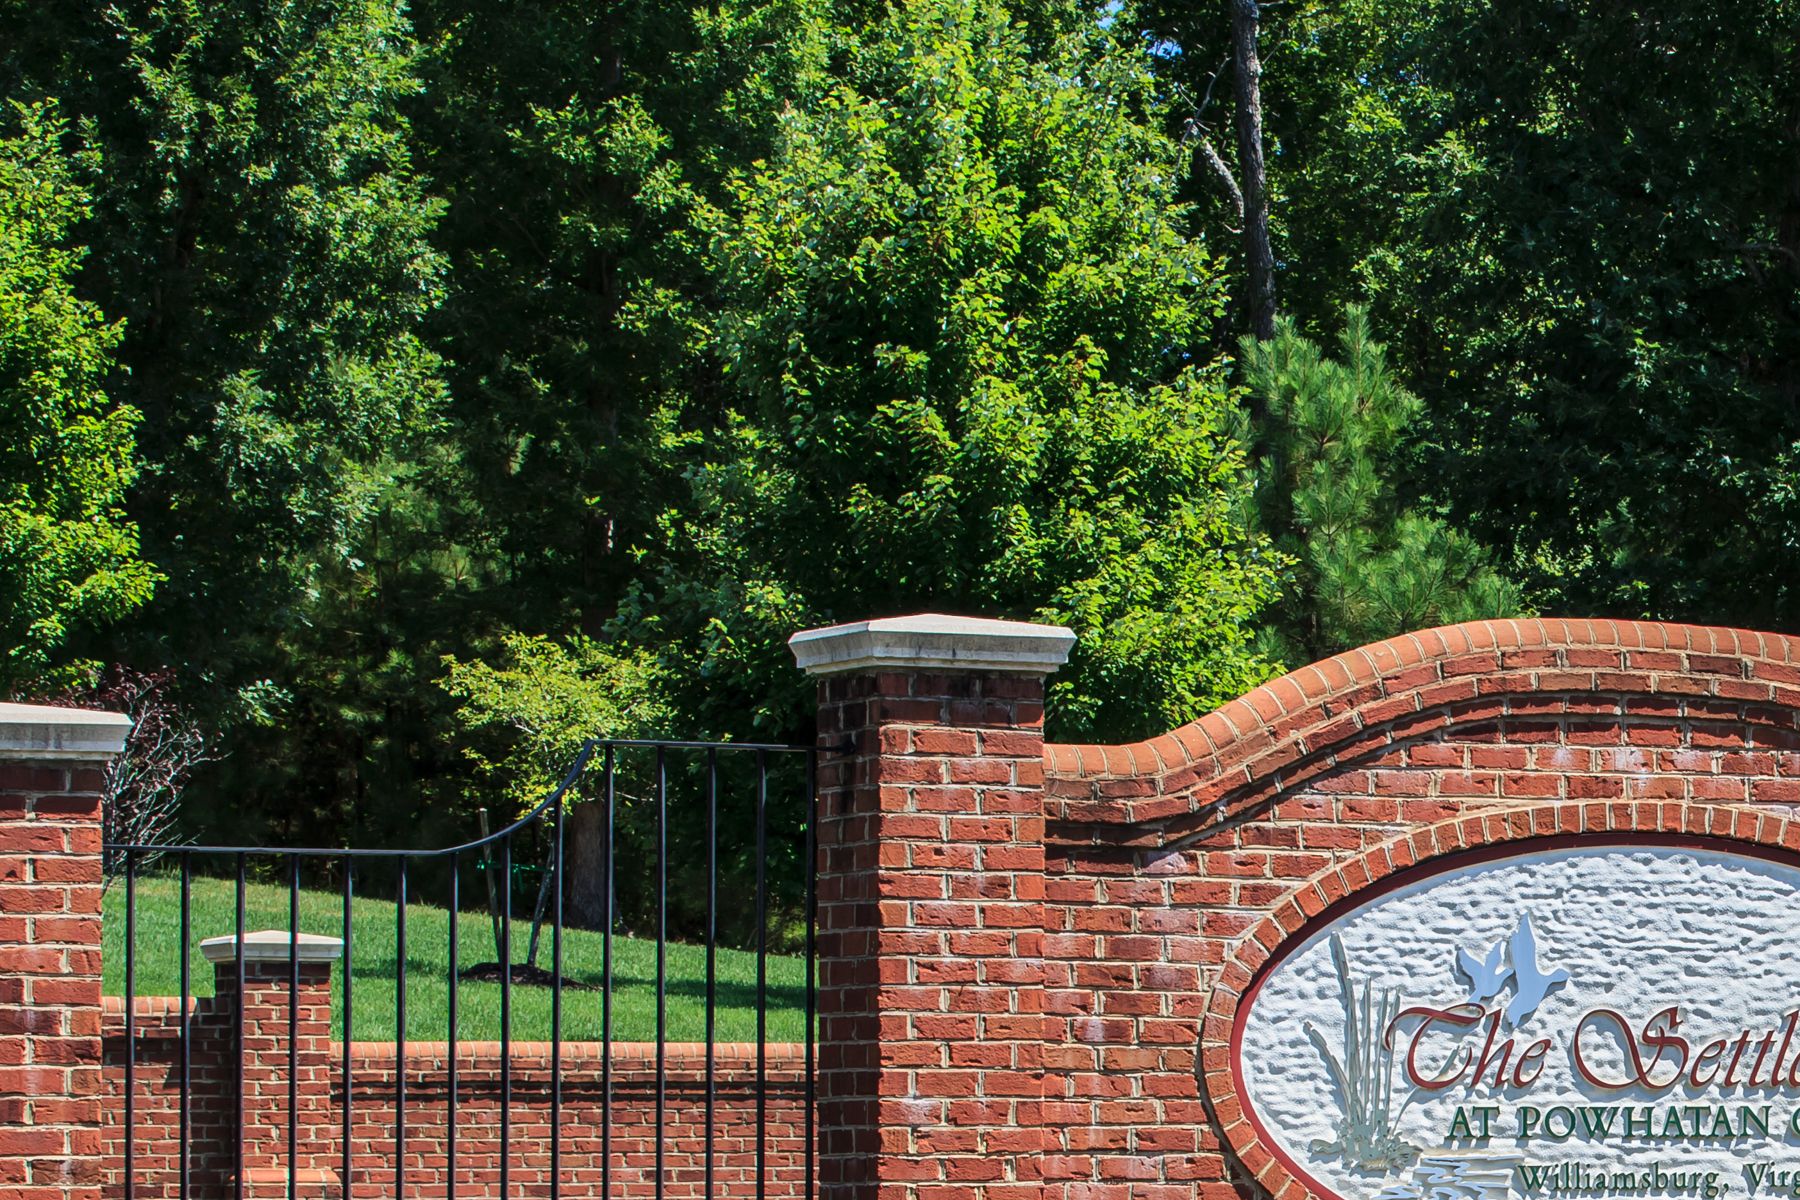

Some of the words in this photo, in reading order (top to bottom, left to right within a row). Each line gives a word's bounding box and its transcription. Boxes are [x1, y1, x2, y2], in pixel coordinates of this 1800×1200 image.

[1384, 1003, 1552, 1090] The
[1447, 1105, 1499, 1139] AT
[1519, 1105, 1771, 1139] POWHATAN
[1518, 1163, 1730, 1198] Williamsburg,
